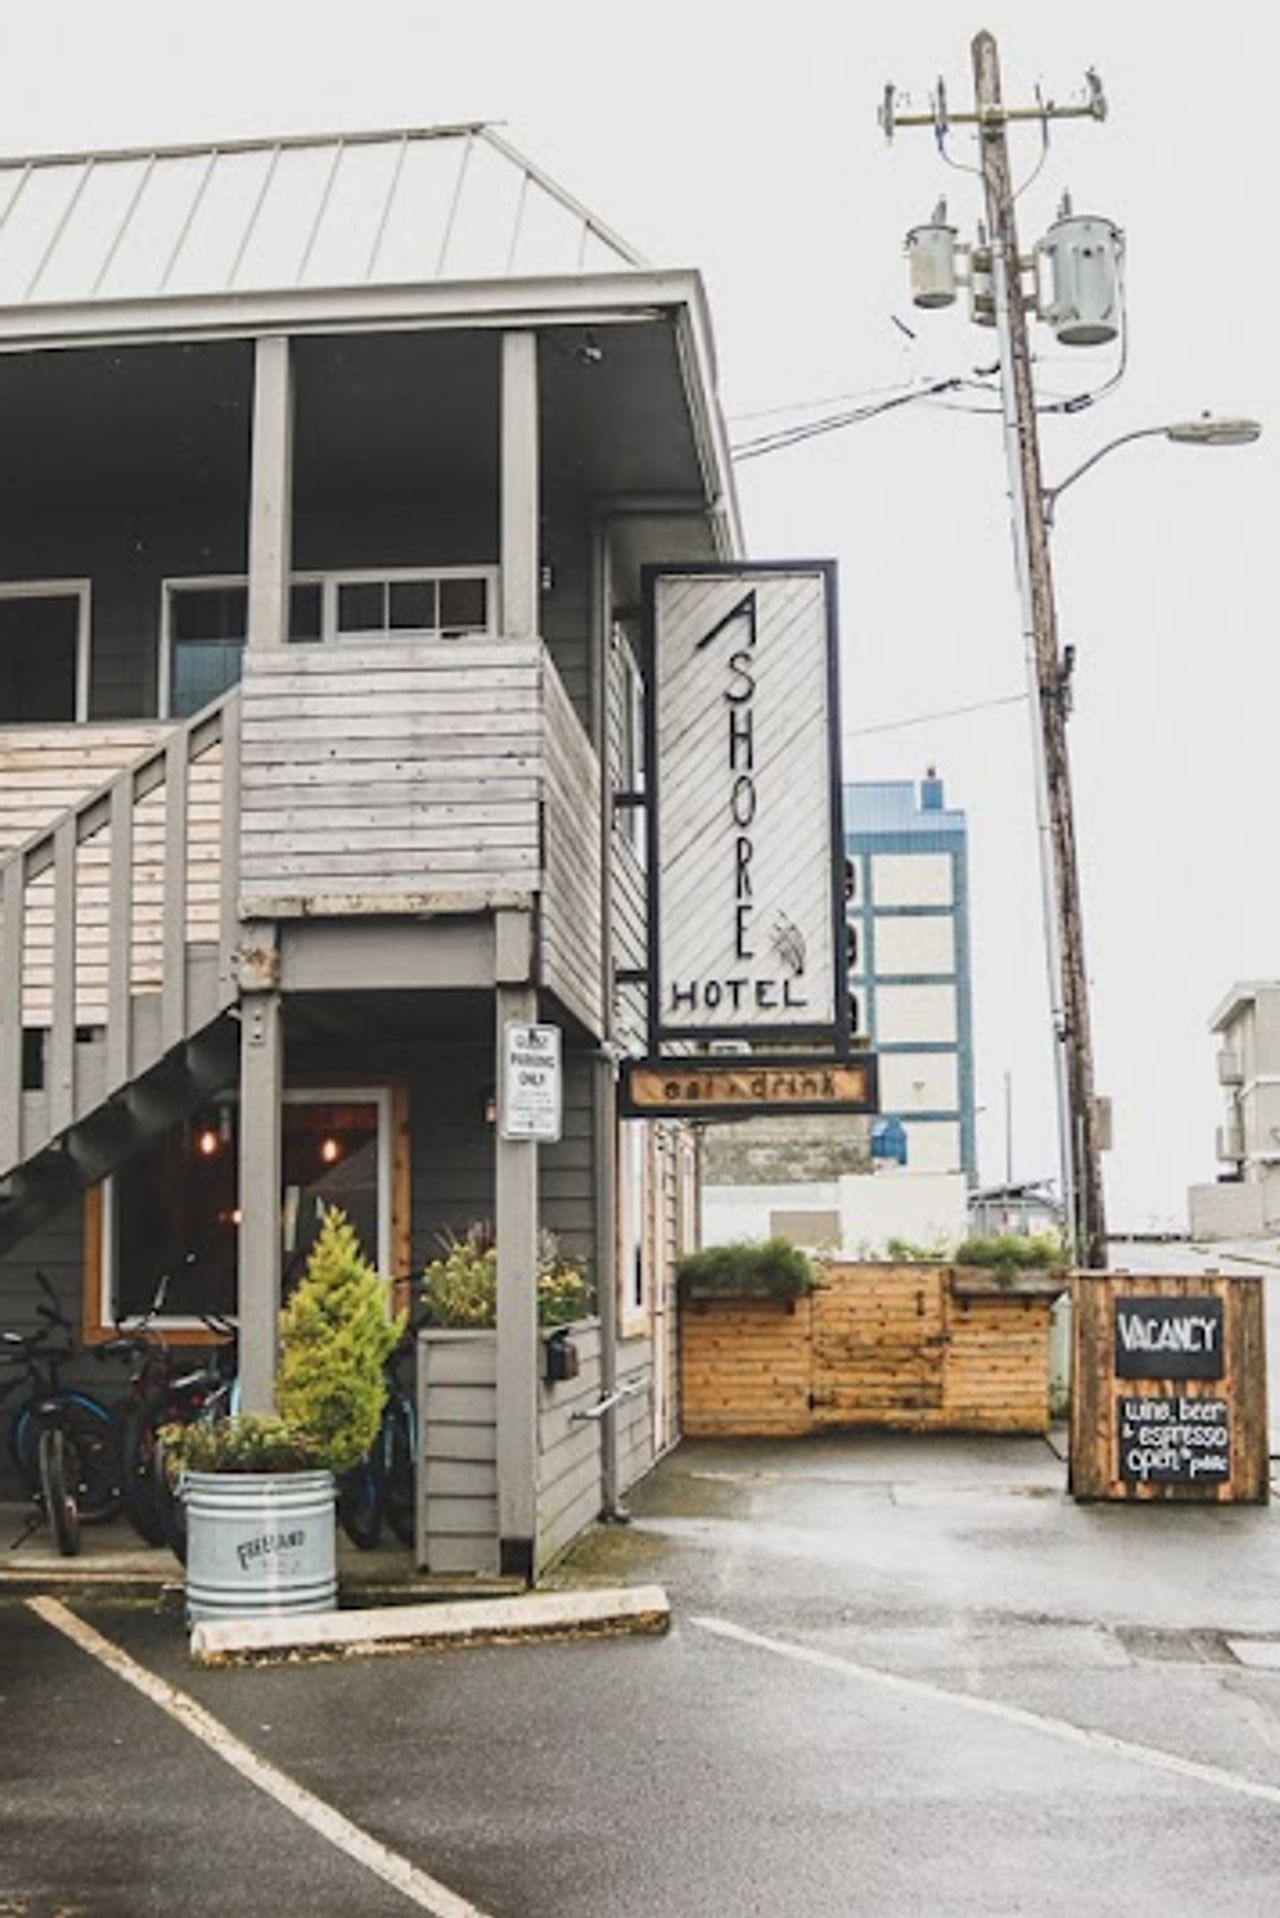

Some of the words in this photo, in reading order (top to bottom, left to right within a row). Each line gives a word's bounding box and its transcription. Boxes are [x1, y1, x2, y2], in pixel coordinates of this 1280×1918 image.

[696, 588, 756, 960] ASHORE
[672, 979, 807, 1011] HOTEL
[751, 1071, 836, 1101] drink
[1118, 1314, 1217, 1352] VACANCY
[1180, 1398, 1226, 1421] beer
[1139, 1425, 1227, 1451] espresso
